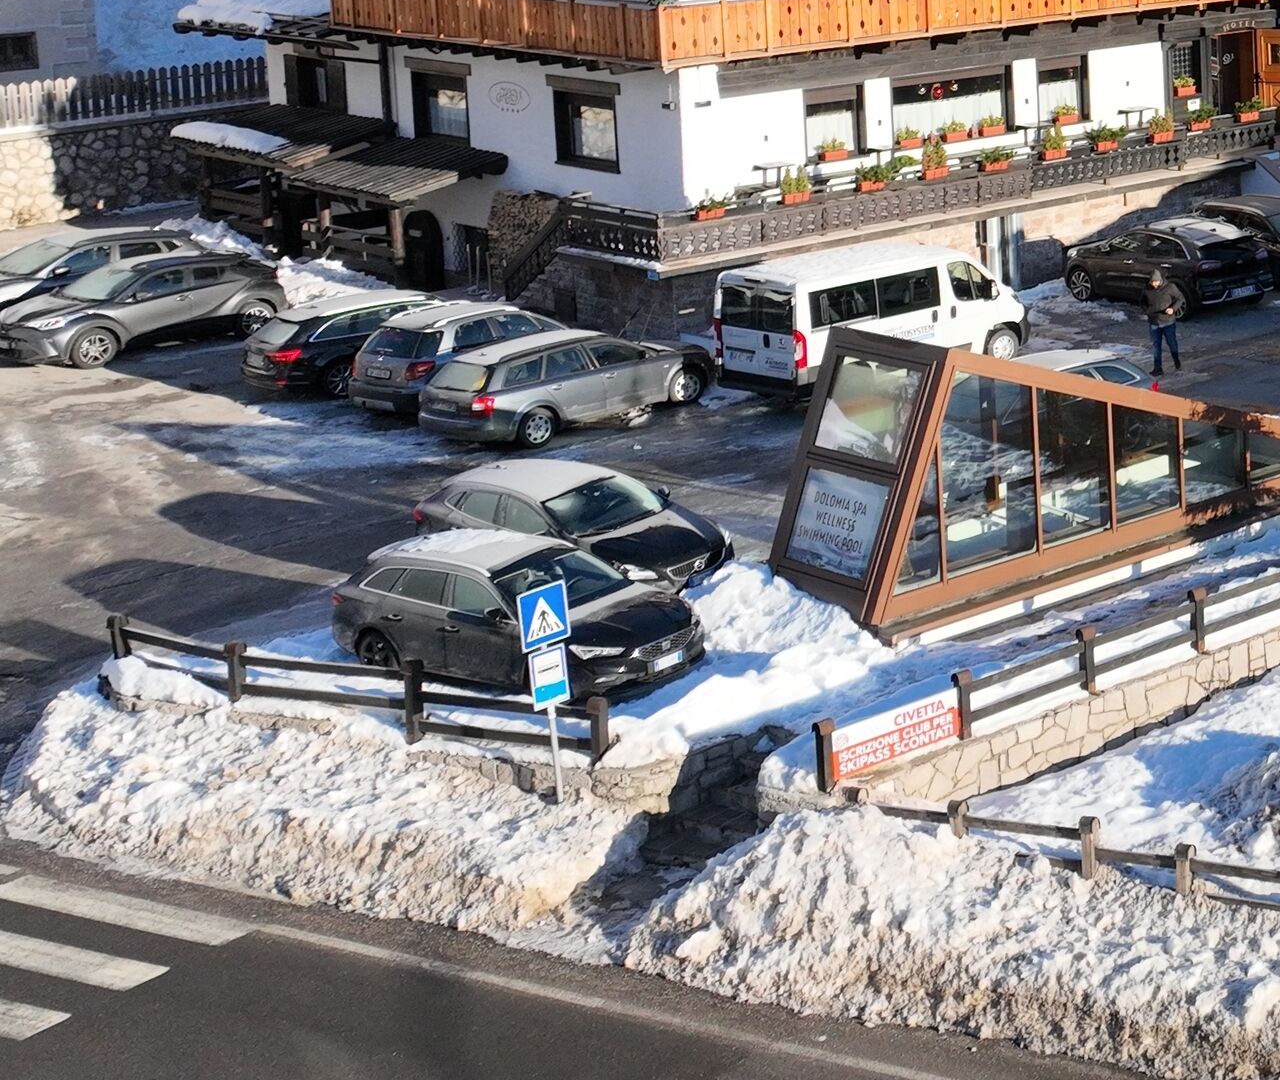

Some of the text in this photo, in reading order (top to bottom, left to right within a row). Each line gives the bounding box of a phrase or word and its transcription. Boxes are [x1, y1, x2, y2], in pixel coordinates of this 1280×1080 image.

[1222, 20, 1256, 32] HOTEL
[814, 490, 867, 517] DOLOMIA SPA
[815, 509, 857, 533] WELLNESS
[799, 524, 864, 554] SWIMMING POOL
[893, 700, 945, 727] CIVETTA
[838, 732, 900, 762] ISCRIZIONE
[902, 719, 931, 740] CLUB
[933, 712, 953, 728] PER
[838, 723, 954, 776] SKIPASS SCONTATI
